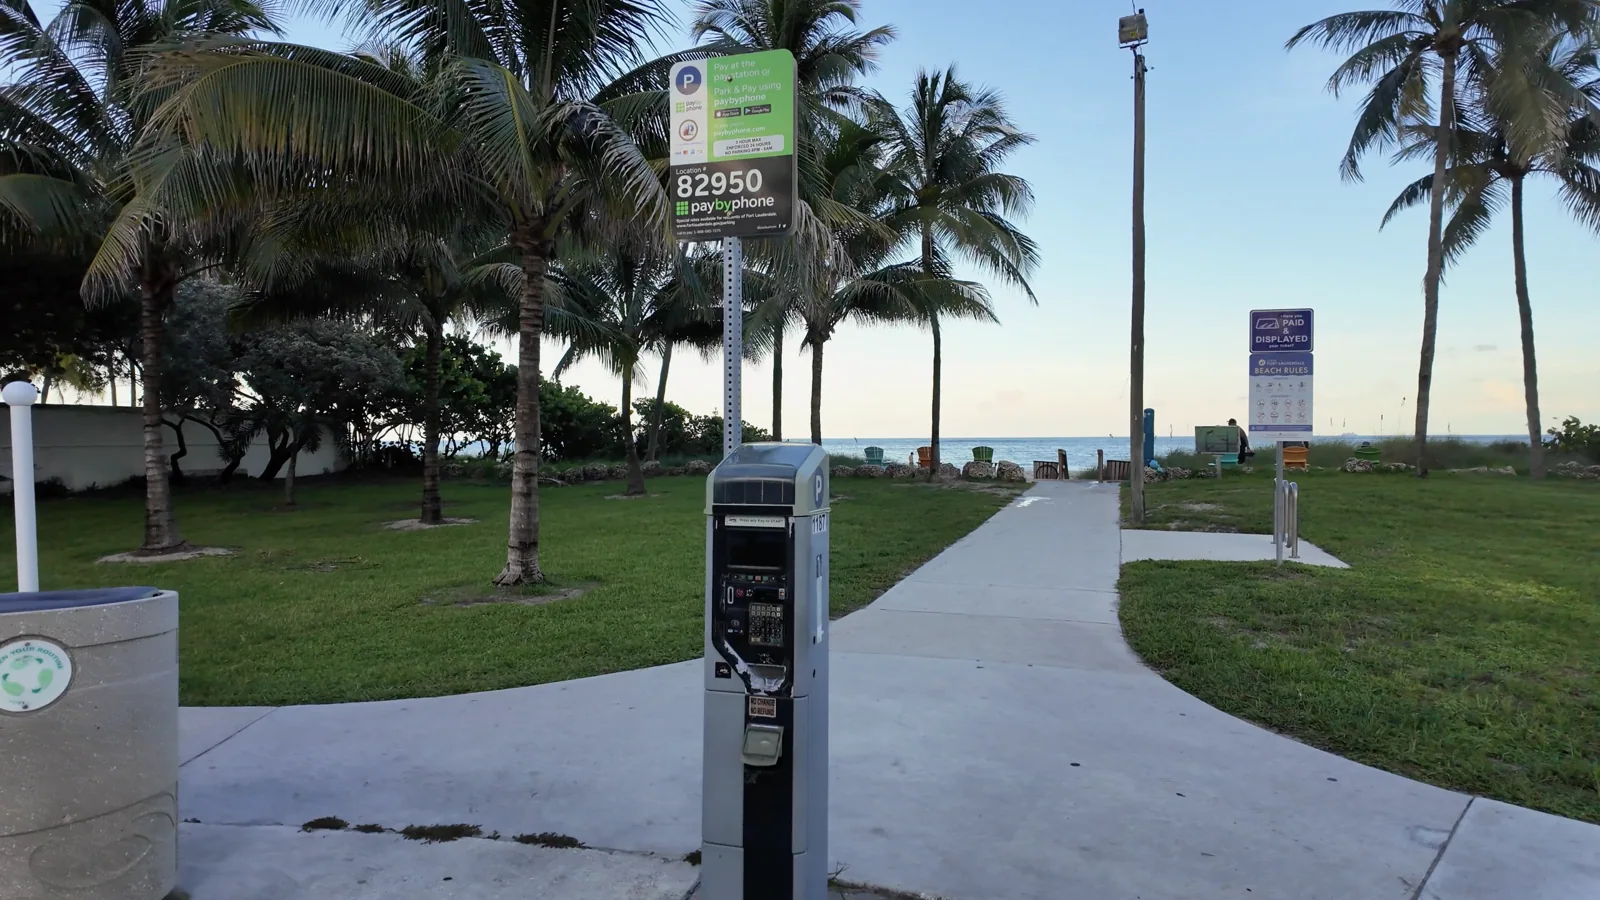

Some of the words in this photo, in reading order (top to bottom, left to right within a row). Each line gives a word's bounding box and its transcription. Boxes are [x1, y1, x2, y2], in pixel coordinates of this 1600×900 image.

[714, 88, 731, 96] Park
[742, 84, 756, 93] Pay
[759, 82, 781, 90] using
[714, 94, 766, 107] paybyphone
[676, 167, 701, 175] Location
[677, 168, 763, 198] 82950
[691, 196, 774, 215] paybyphone
